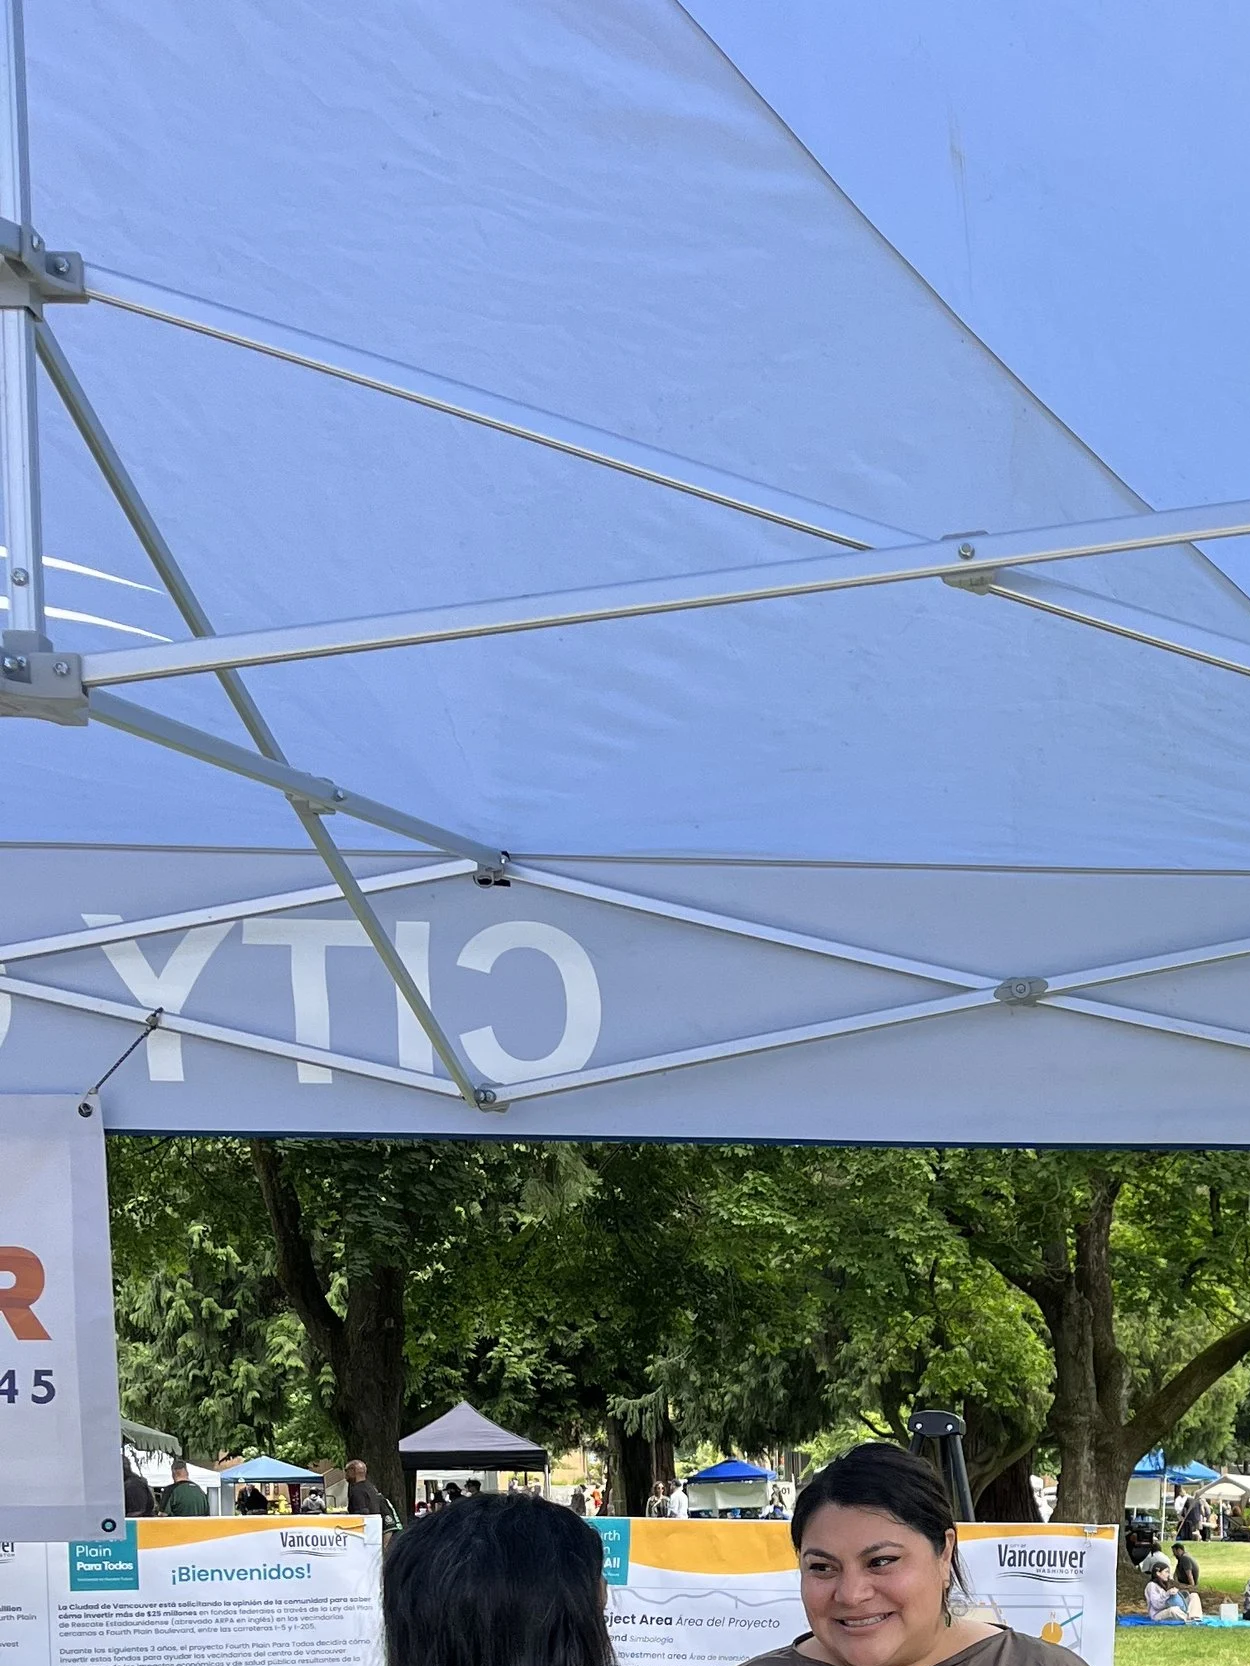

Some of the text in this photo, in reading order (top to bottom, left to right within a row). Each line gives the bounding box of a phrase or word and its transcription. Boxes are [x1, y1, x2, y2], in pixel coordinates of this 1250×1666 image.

[280, 1531, 348, 1549] Vancouver
[76, 1545, 112, 1557] Plain
[997, 1543, 1086, 1568] Vancouver
[76, 1560, 134, 1572] Para Todos
[171, 1563, 312, 1586] ¡Bienvenidos!
[16, 1613, 37, 1621] Plain
[639, 1615, 673, 1626] Area
[676, 1613, 703, 1627] Área
[706, 1616, 725, 1627] del
[728, 1617, 780, 1630] Proyecto
